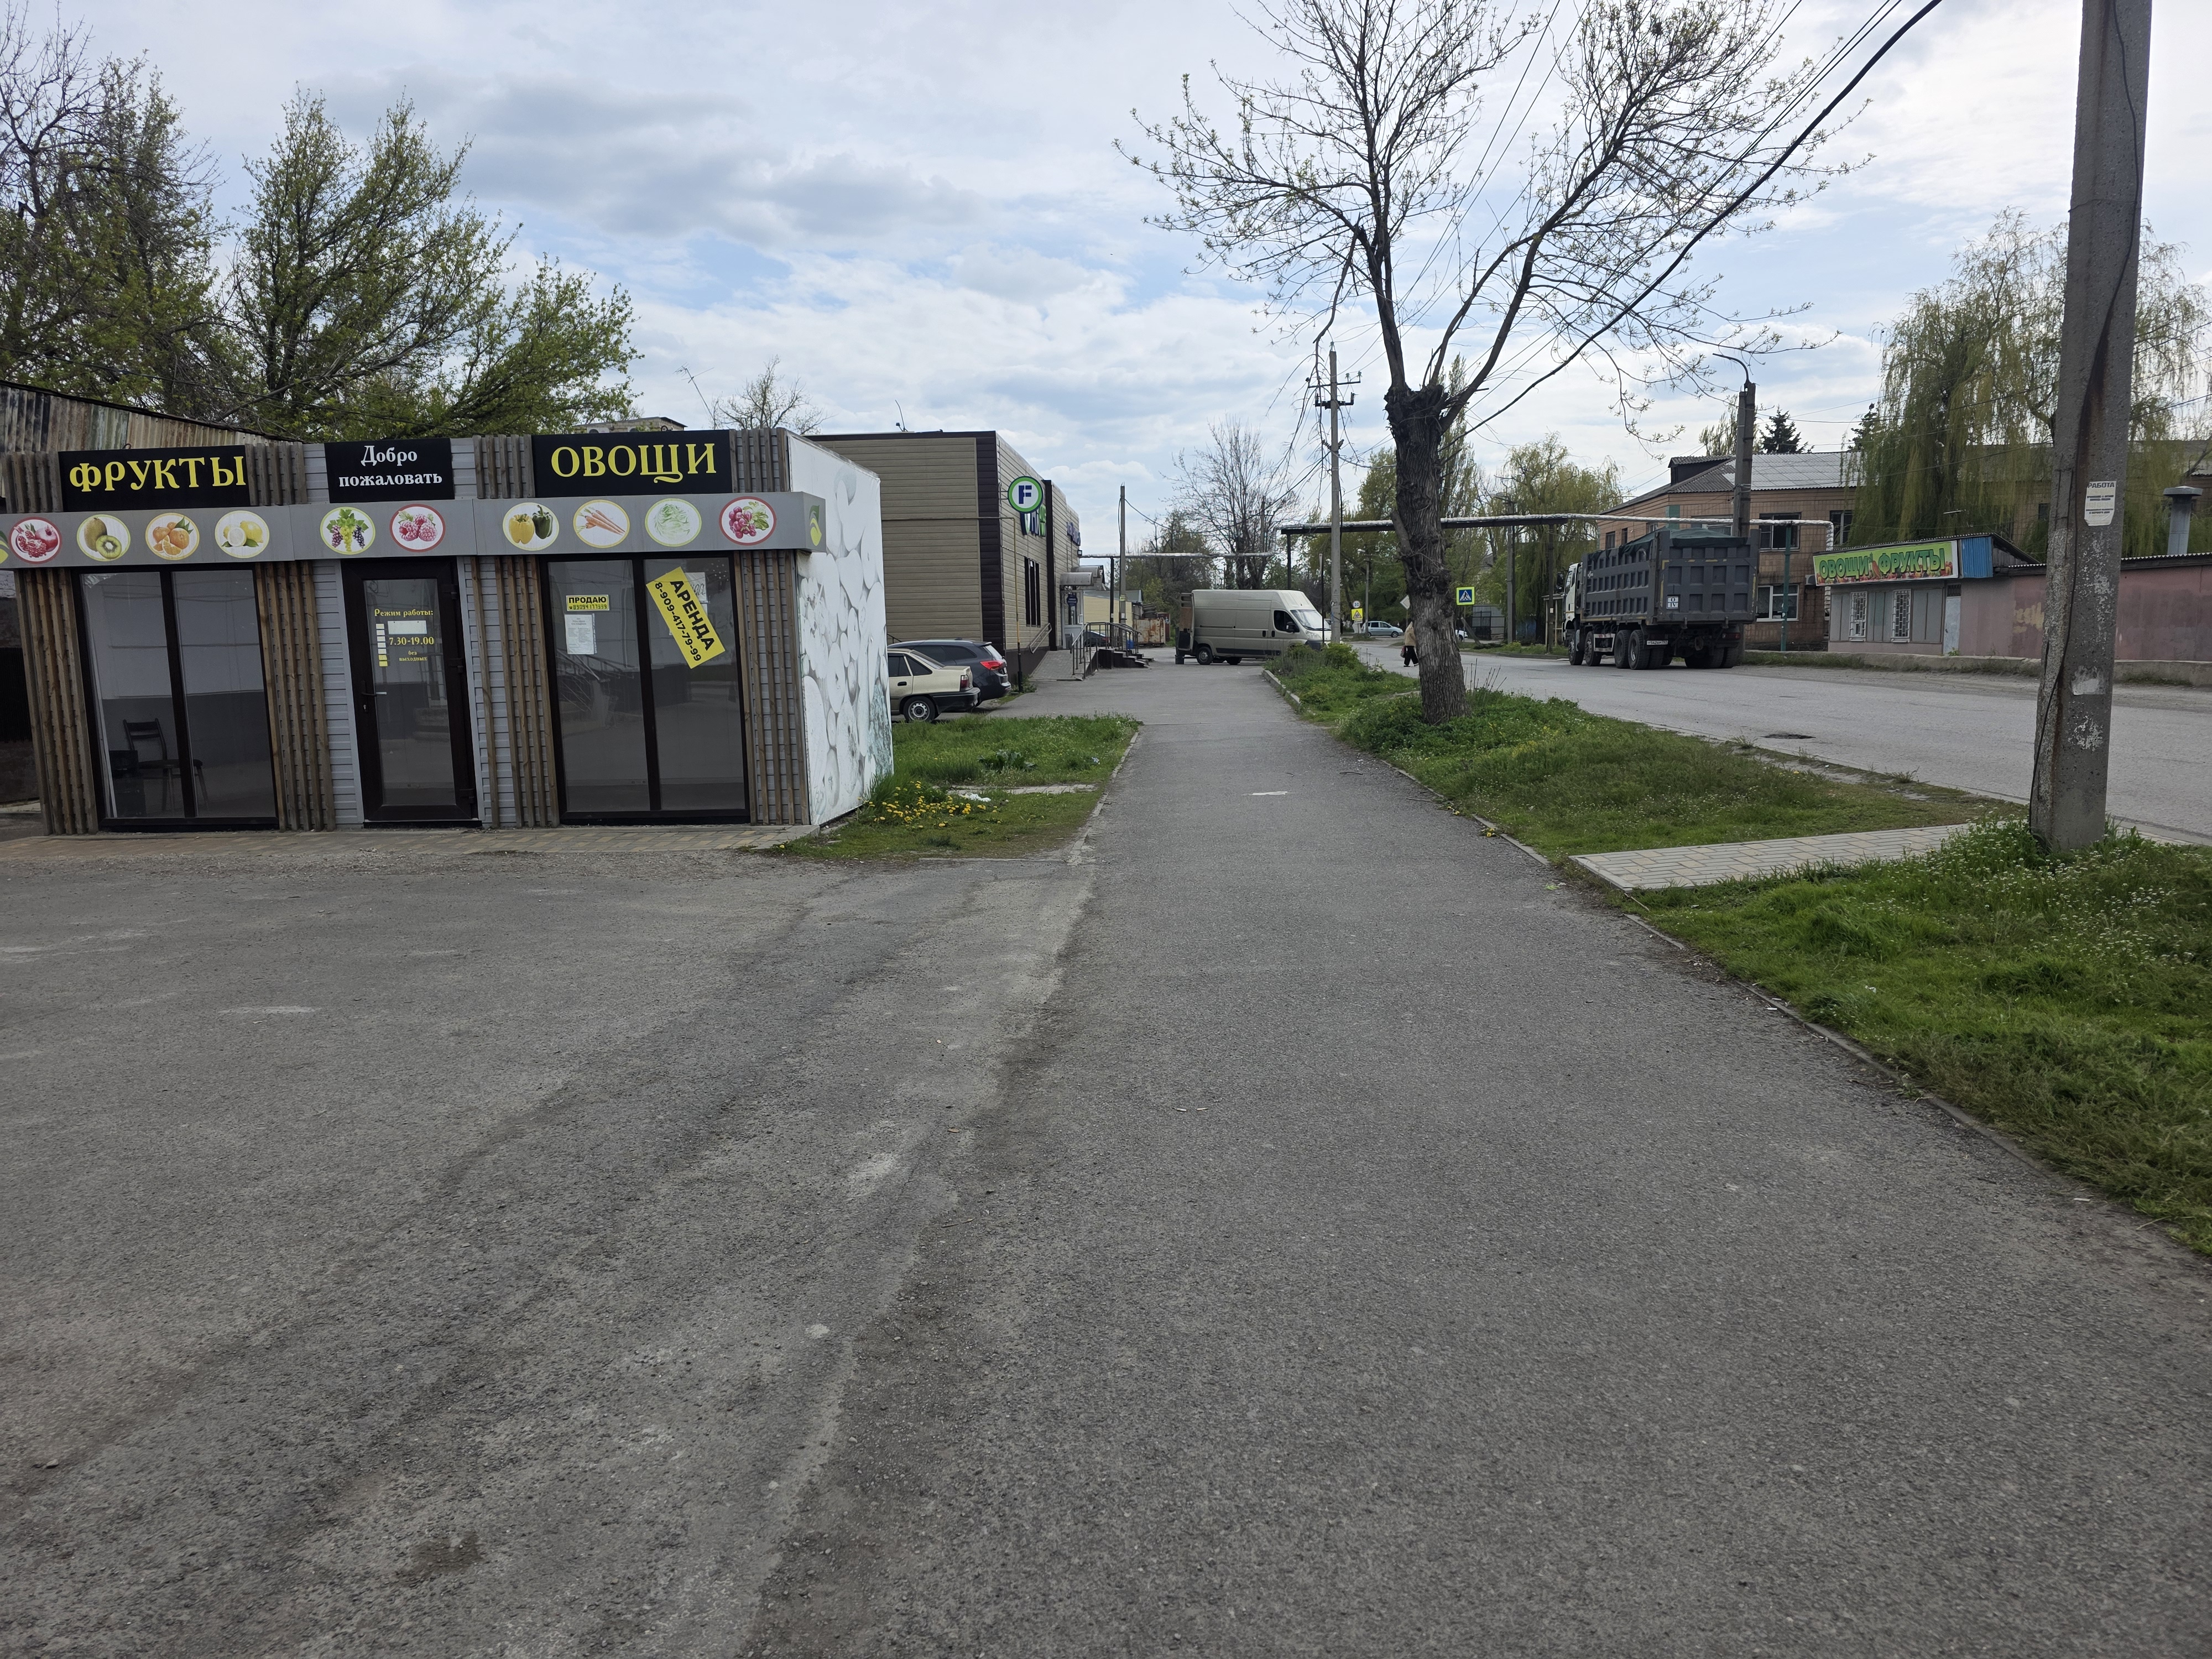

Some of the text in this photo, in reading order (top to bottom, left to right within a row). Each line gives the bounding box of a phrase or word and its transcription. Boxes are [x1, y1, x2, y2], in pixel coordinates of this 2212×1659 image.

[361, 445, 418, 466] Добро
[551, 443, 717, 483] ОВОЩИ
[69, 456, 246, 492] ФРУКТЫ
[338, 473, 442, 487] пожаловать
[1018, 485, 1032, 504] F
[1819, 548, 1945, 579] ОВОЩИ ФРУКТЫ
[374, 608, 434, 618] Режим работы:
[655, 582, 702, 661] 8-909-417-79-99
[670, 581, 715, 651] АРЕНДА
[389, 637, 434, 645] 7.30-19.00
